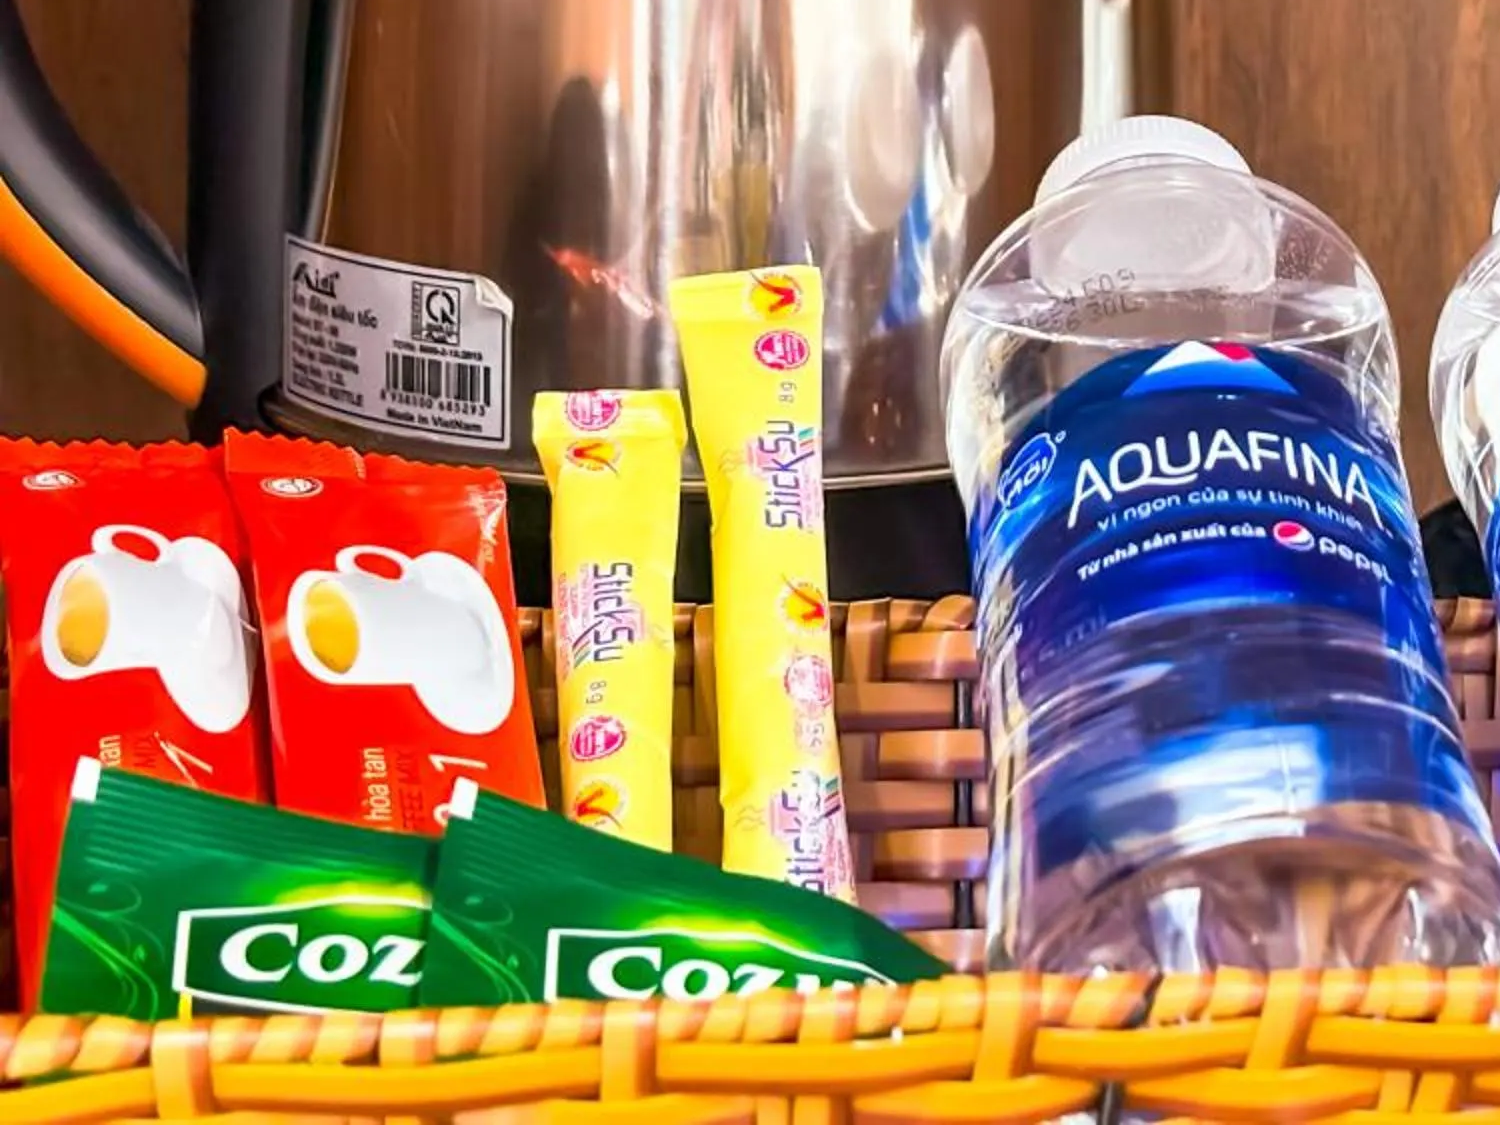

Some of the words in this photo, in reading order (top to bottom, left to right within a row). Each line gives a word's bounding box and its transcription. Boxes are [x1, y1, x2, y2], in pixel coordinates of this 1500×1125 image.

[1067, 428, 1384, 530] AQUAFINA
[1123, 493, 1180, 522] ngon
[1188, 485, 1229, 505] của
[1269, 489, 1311, 512] tinh
[1103, 541, 1140, 568] nhà
[361, 747, 388, 779] tan
[361, 783, 392, 822] hòa
[587, 946, 856, 1001] Coz
